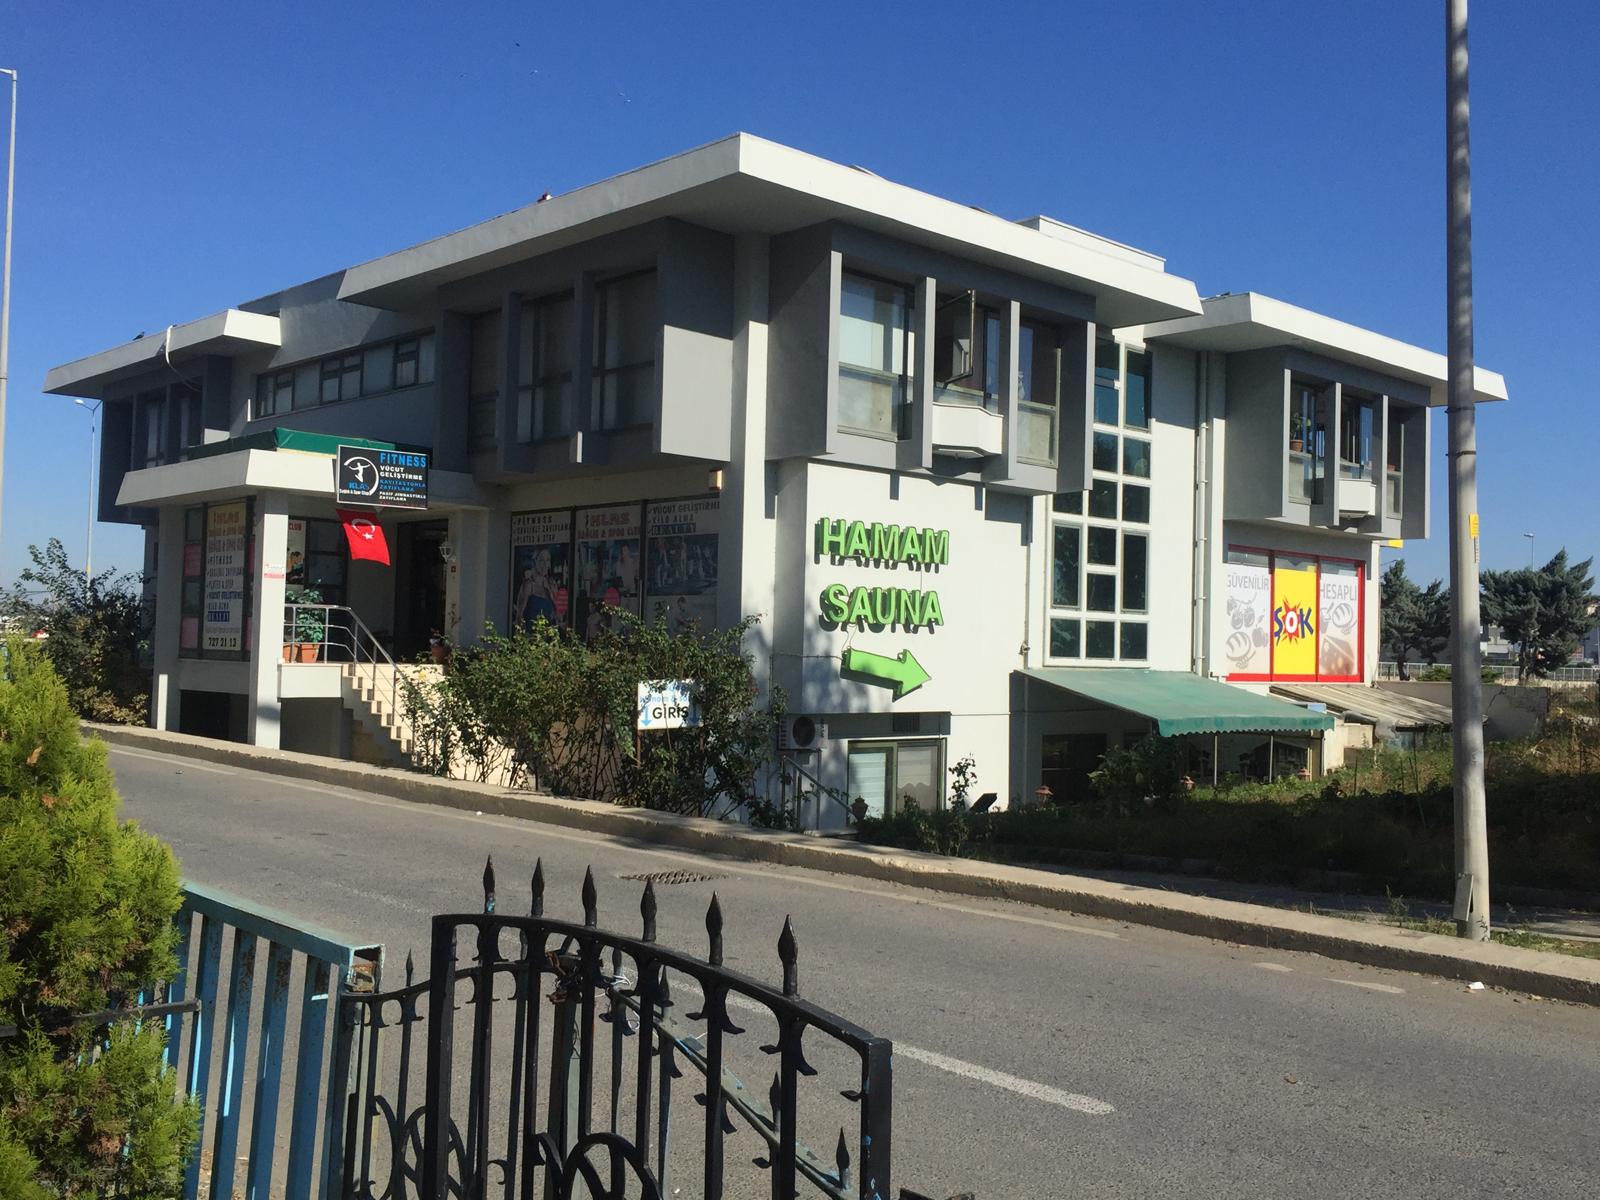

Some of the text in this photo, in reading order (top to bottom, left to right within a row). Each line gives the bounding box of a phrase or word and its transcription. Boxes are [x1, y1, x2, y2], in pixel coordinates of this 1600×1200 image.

[380, 465, 405, 473] VÜCUT
[380, 471, 423, 481] GELİŞTİRME
[820, 517, 949, 566] HAMAM
[826, 583, 945, 627] SAUNA
[1273, 607, 1314, 646] ŞOK
